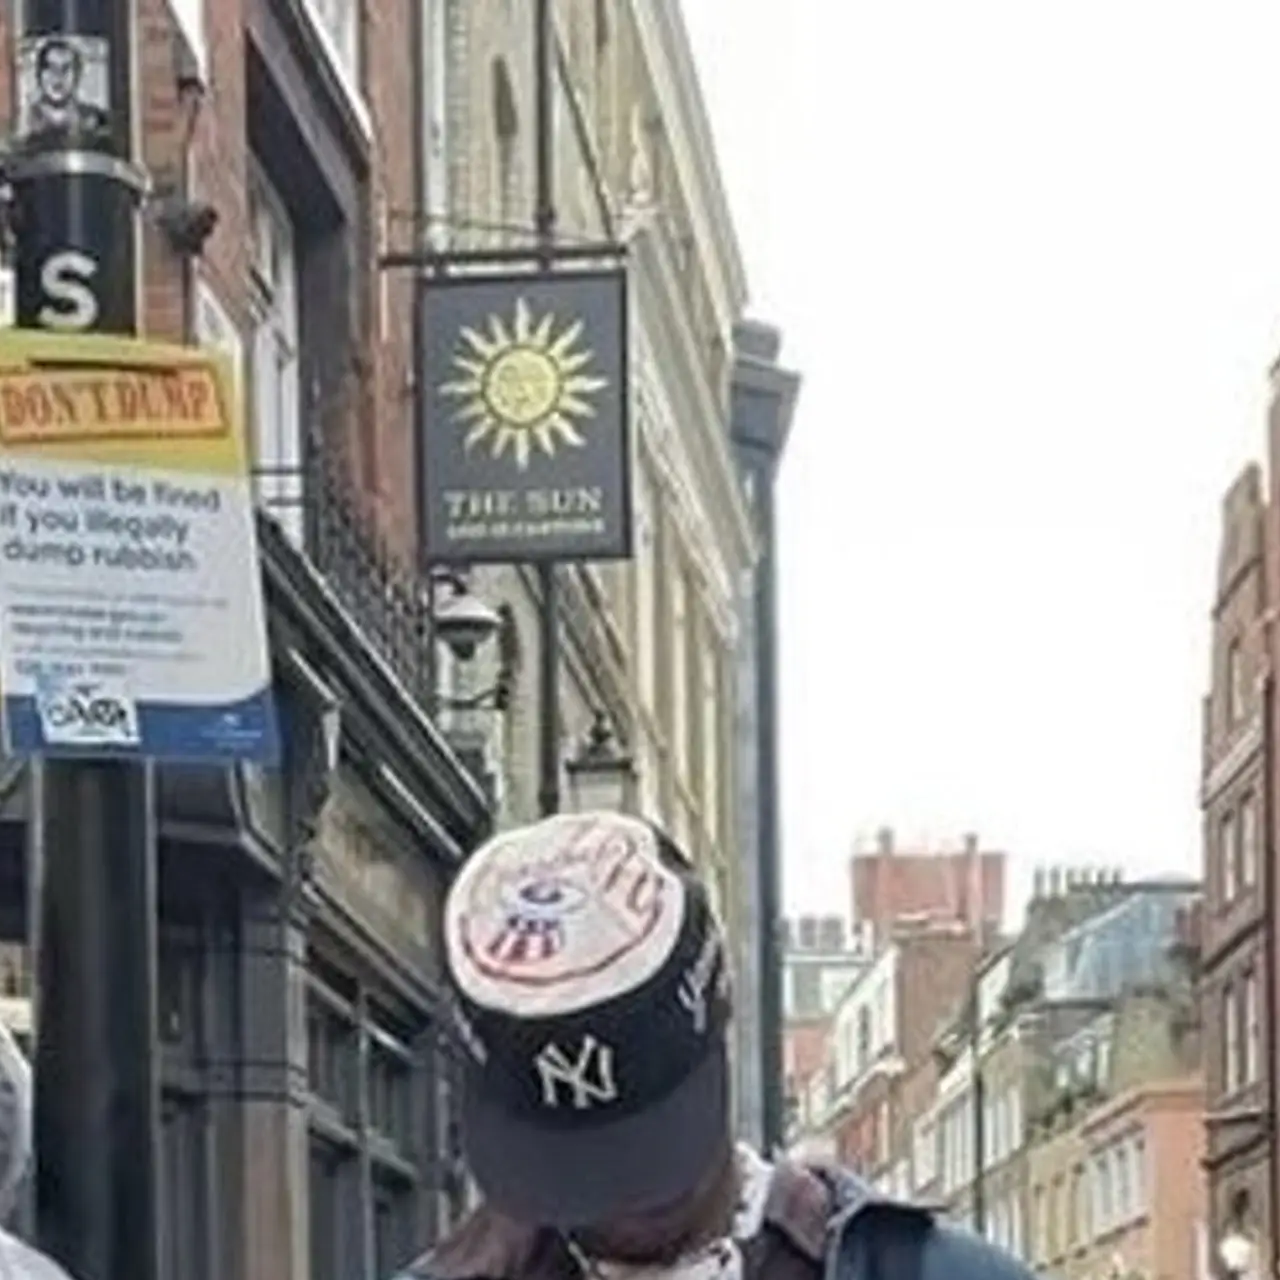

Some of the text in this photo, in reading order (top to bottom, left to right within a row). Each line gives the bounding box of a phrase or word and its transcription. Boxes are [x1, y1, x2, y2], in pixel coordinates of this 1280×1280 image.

[113, 374, 210, 423] DUMP
[55, 475, 106, 500] will
[111, 479, 147, 504] be
[152, 481, 220, 513] fined
[442, 484, 603, 518] THE SUN
[0, 503, 189, 544] if you illegally
[2, 540, 197, 571] dump rubbish
[532, 1034, 618, 1109] NY
